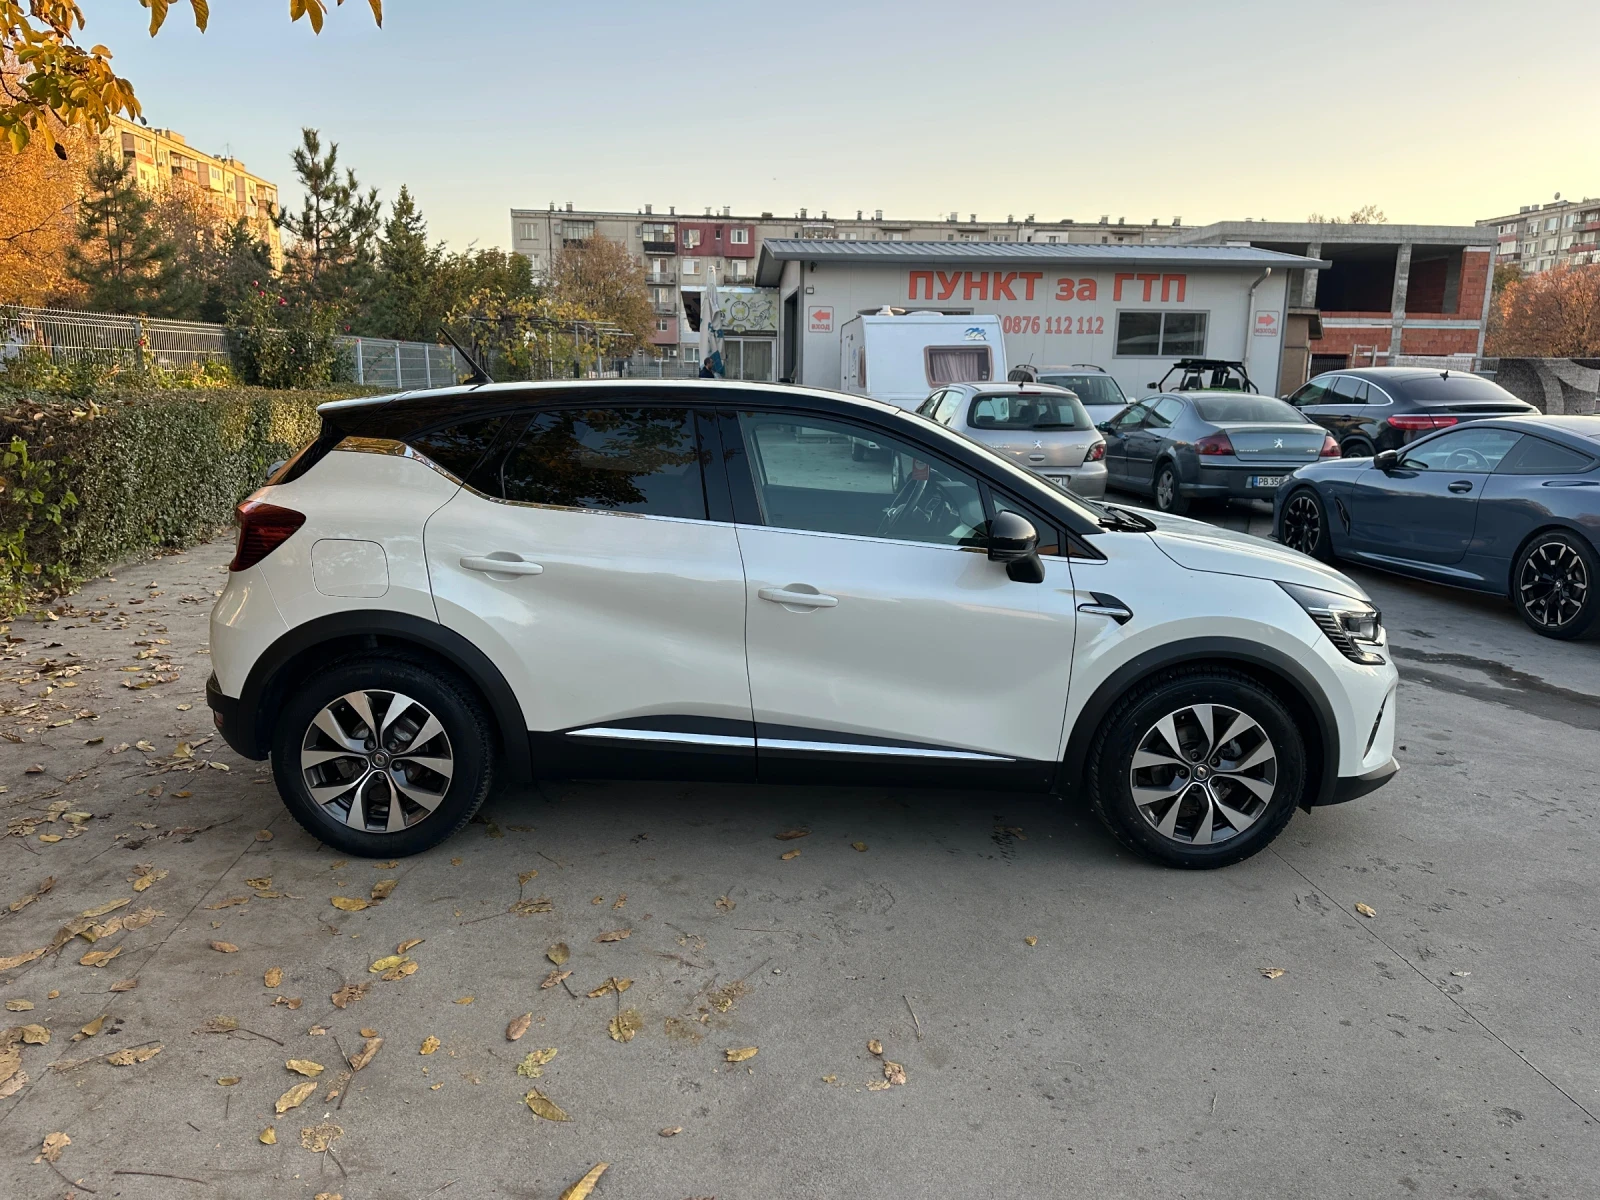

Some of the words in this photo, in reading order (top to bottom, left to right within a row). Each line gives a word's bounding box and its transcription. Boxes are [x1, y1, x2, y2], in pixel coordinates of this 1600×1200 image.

[908, 270, 1043, 301] ПУНКТ
[1055, 277, 1097, 301] за
[1113, 272, 1187, 302] ГТП
[811, 323, 831, 331] ВХОД
[1003, 315, 1041, 334] 0876
[1044, 316, 1073, 335] 112
[1076, 316, 1105, 335] 112
